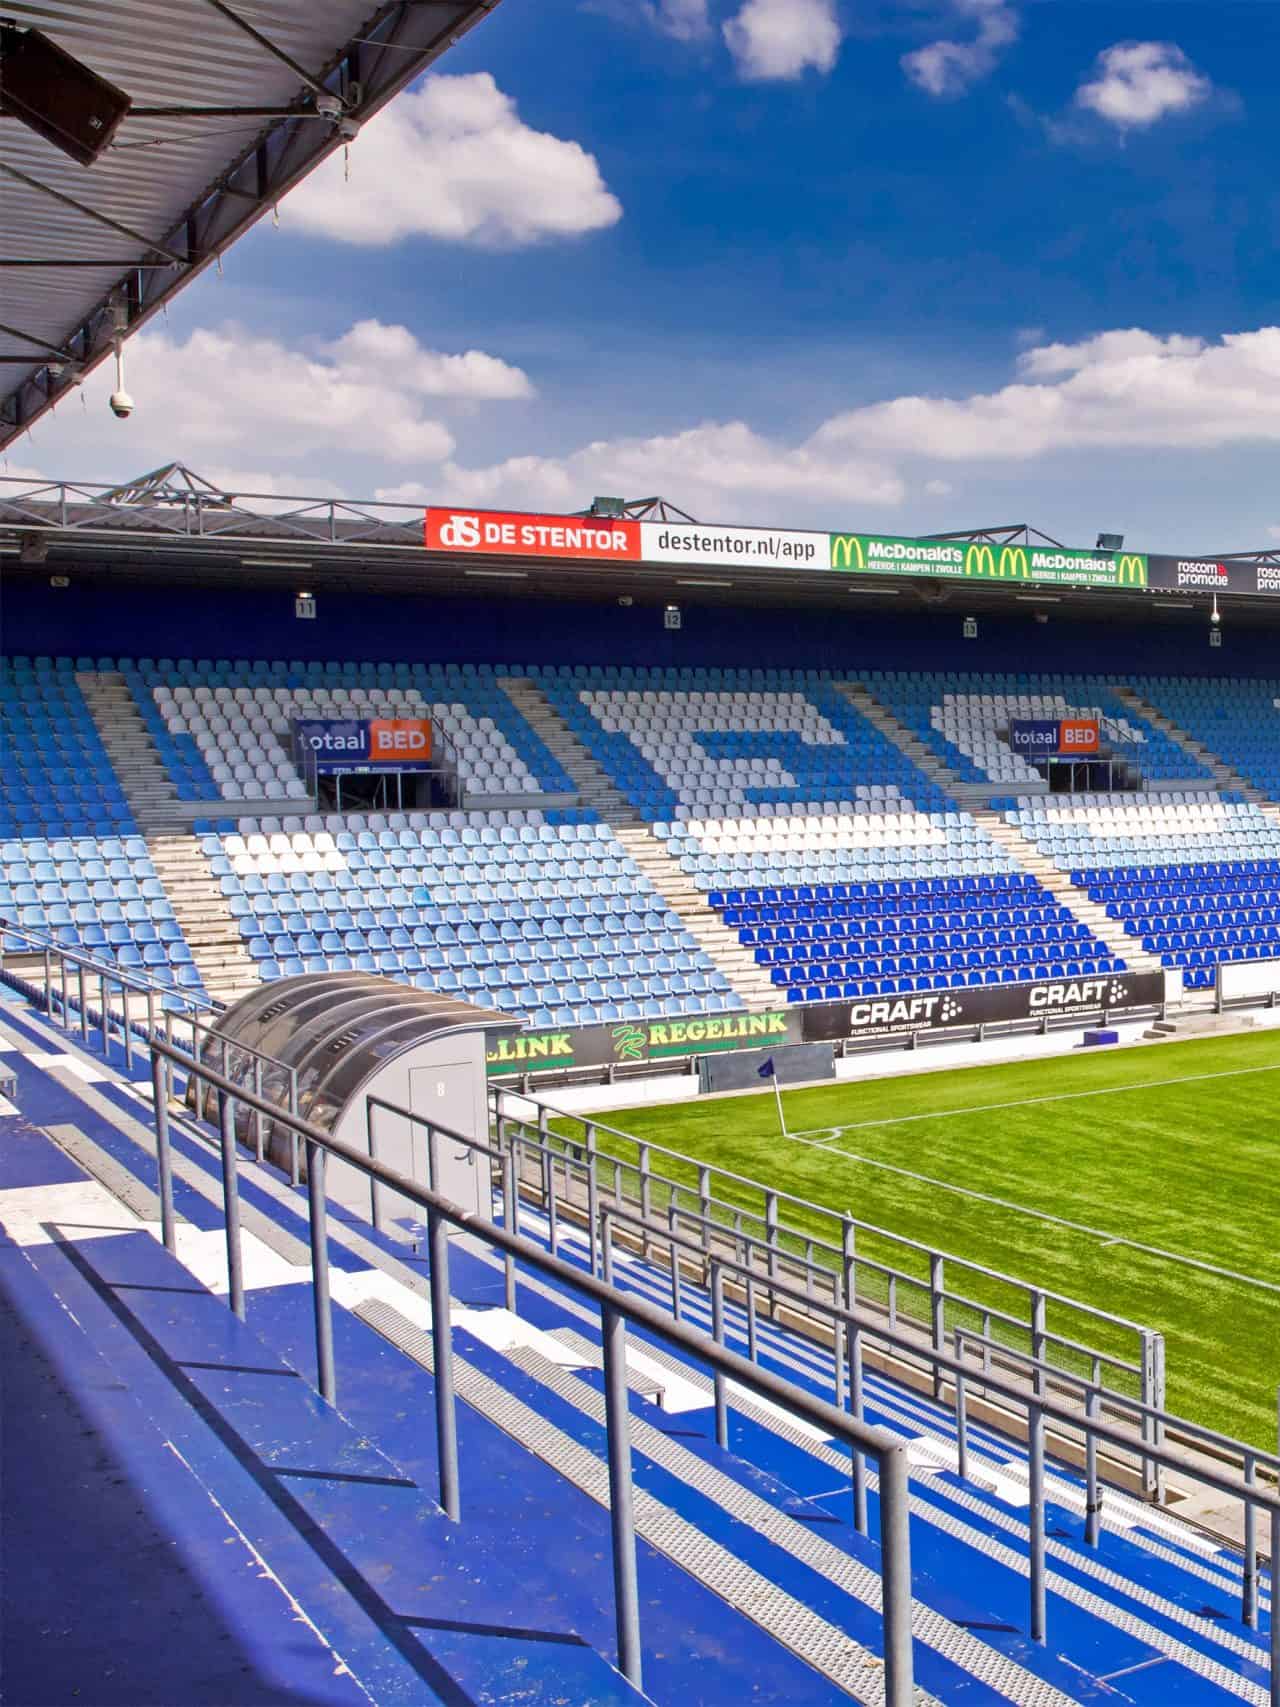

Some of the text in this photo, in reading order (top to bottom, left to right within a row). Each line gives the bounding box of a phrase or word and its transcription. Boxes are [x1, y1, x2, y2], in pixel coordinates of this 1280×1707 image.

[485, 524, 627, 550] DE STENTOR
[658, 531, 815, 560] destentor.nl/app
[867, 542, 963, 562] McDonald's
[1178, 561, 1217, 574] roscom
[1178, 572, 1228, 586] promotie
[298, 729, 425, 750] totaal BED
[1013, 728, 1095, 744] totaal BED
[1029, 980, 1108, 1007] CRAFT
[851, 997, 940, 1025] CRAFT
[649, 1013, 787, 1044] REGELINK
